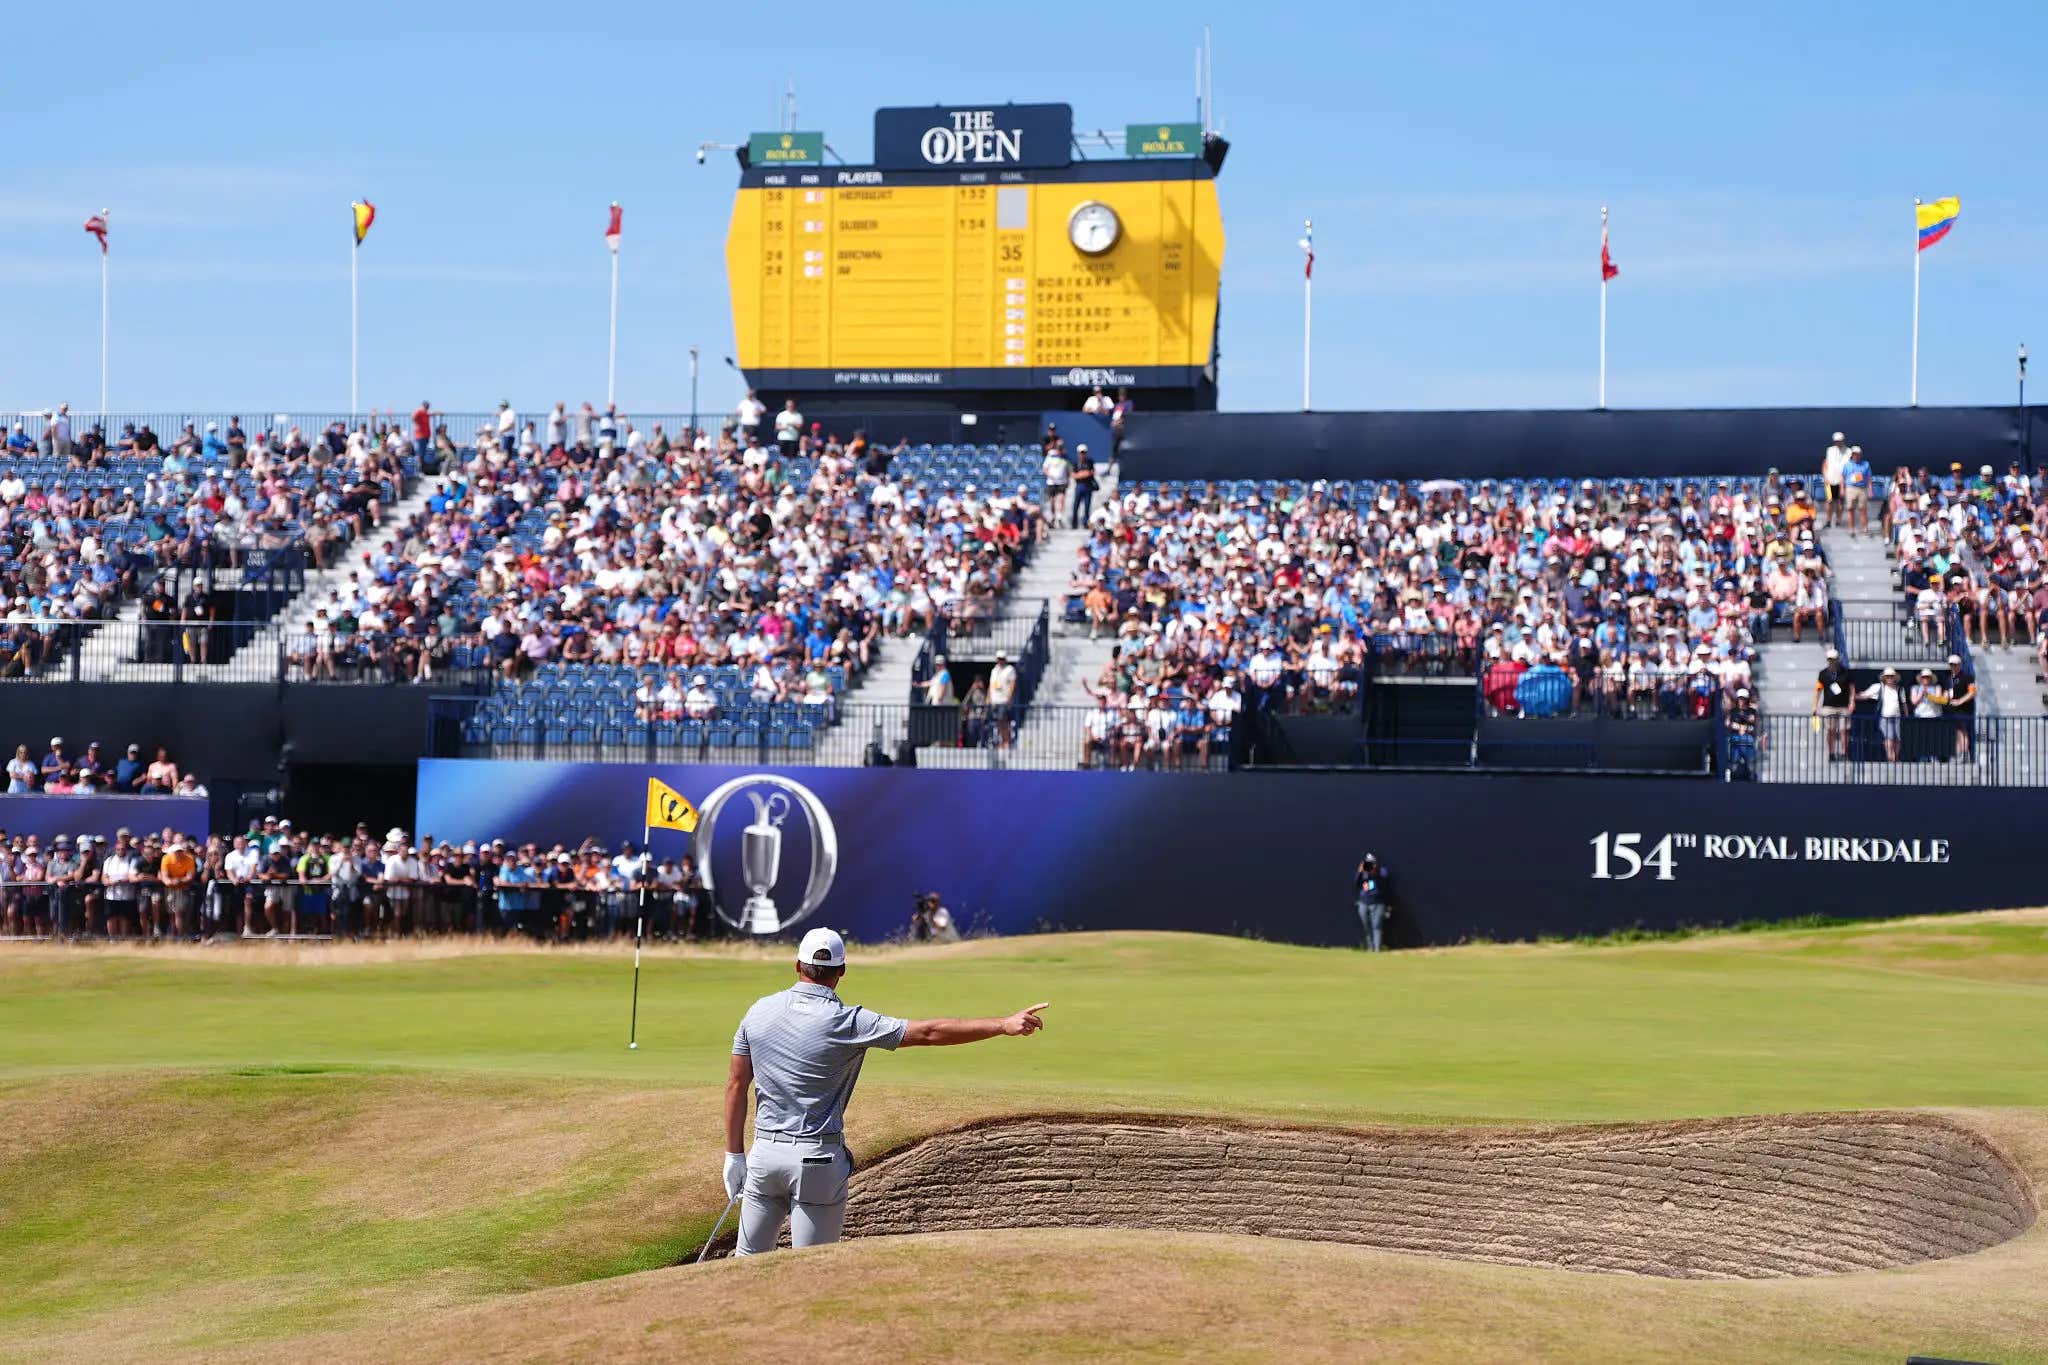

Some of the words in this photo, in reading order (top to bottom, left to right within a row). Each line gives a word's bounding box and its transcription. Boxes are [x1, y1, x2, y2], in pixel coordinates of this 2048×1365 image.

[950, 111, 994, 130] THE
[921, 126, 1023, 164] OPEN
[1142, 141, 1184, 153] ROLEX
[765, 149, 807, 160] ROLEX
[838, 171, 883, 184] PLAYER
[1001, 245, 1022, 261] 35
[1036, 352, 1081, 363] SCOTT
[1589, 831, 1697, 881] 154TH
[1704, 833, 1797, 860] ROYAL
[1804, 836, 1950, 863] BIRKDALE
